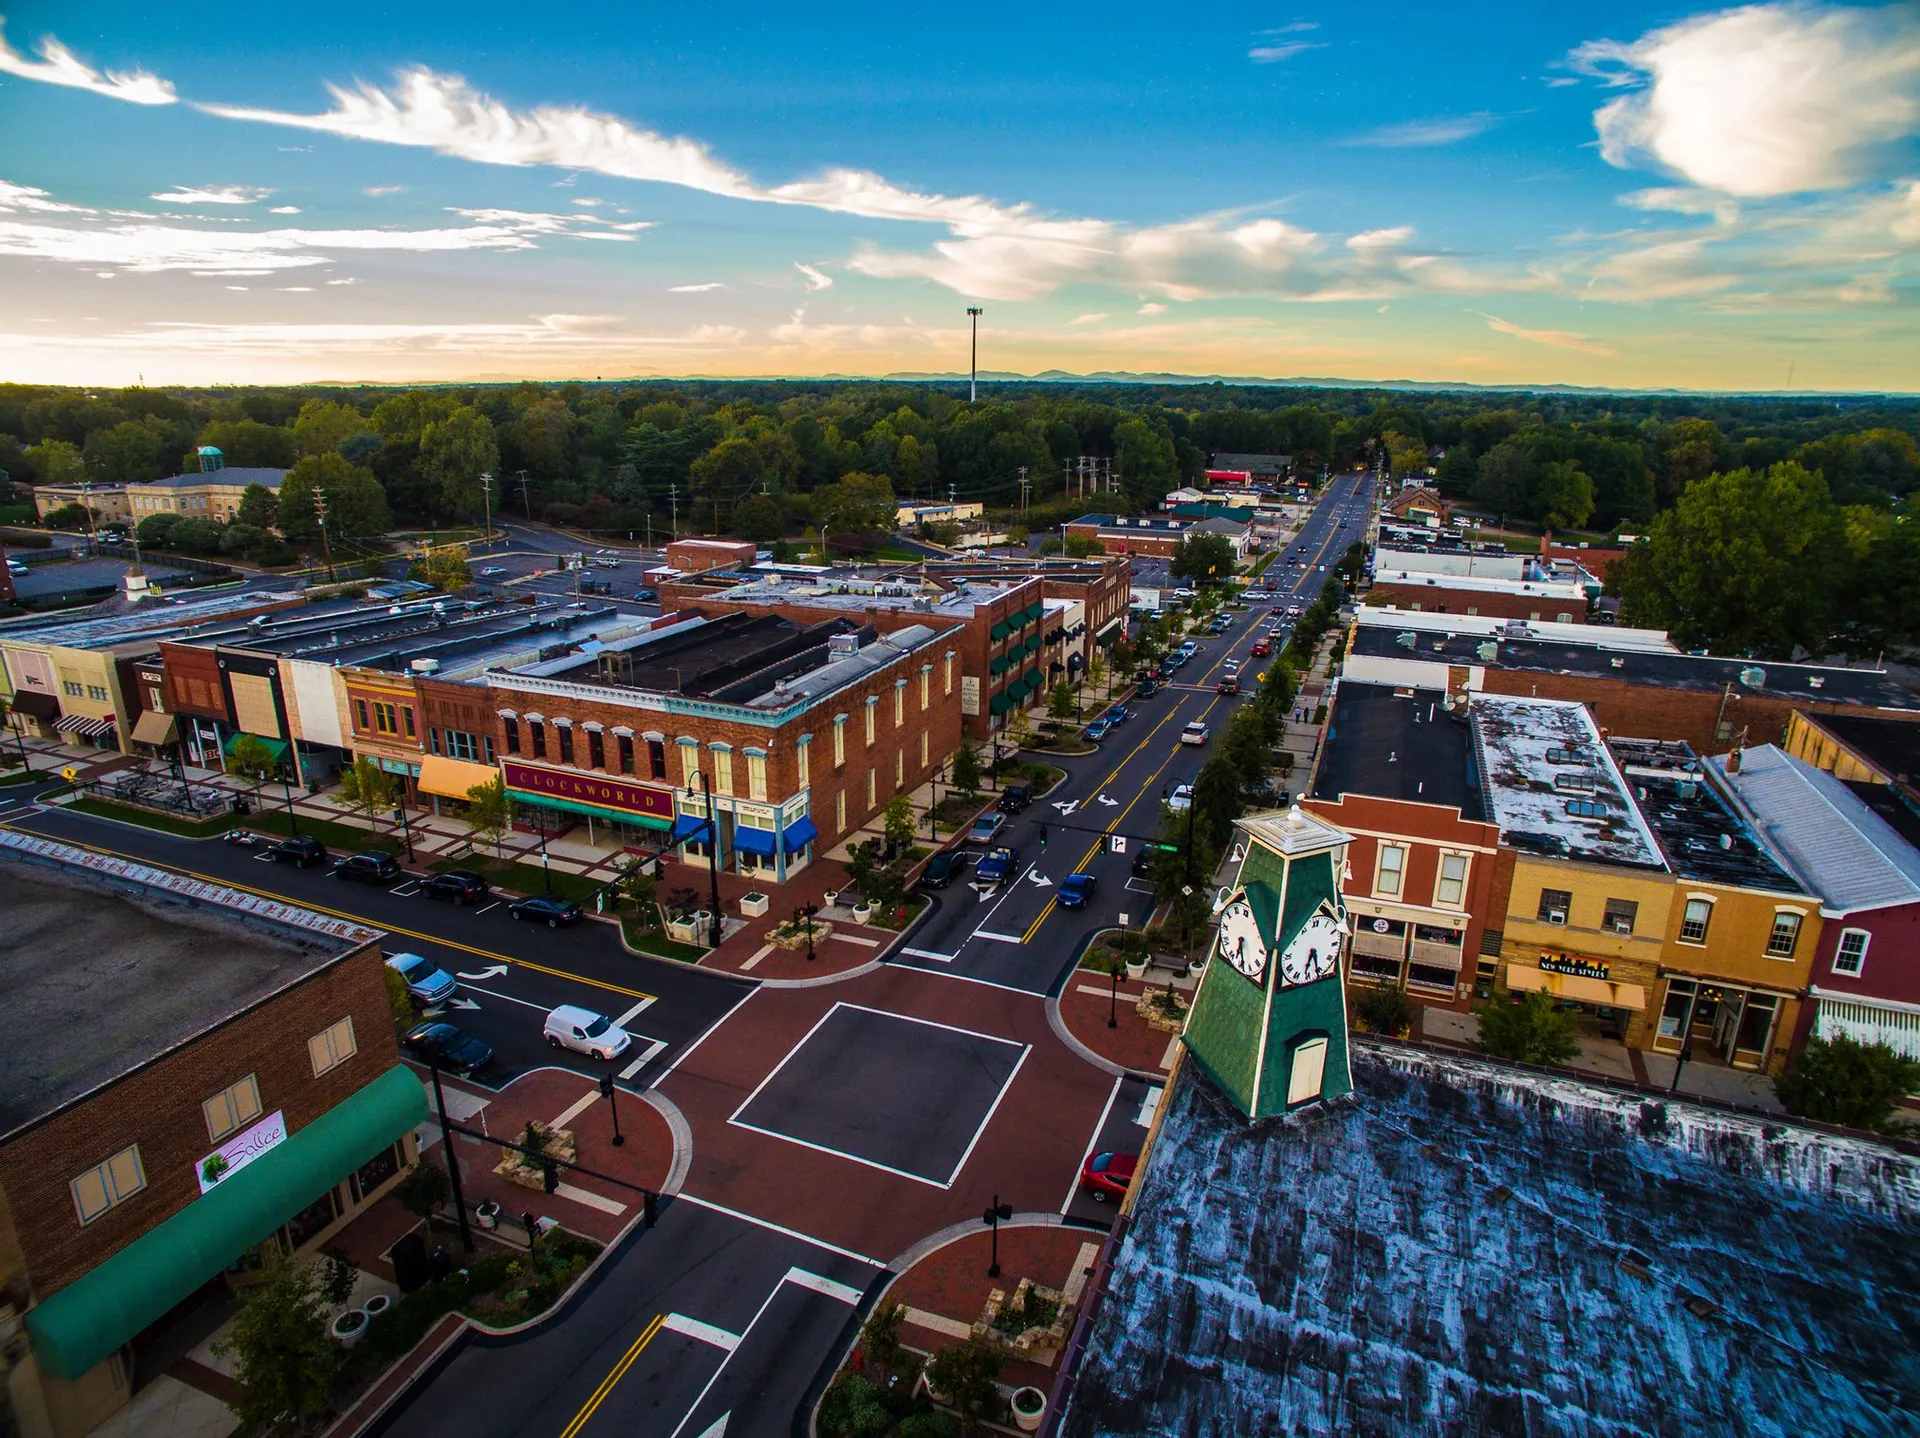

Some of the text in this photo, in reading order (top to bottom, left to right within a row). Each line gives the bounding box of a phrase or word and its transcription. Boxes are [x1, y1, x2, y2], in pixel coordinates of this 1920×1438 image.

[519, 772, 654, 807] CLOCKWORLD
[1541, 961, 1556, 970] NEW
[1578, 968, 1605, 978] STYLES
